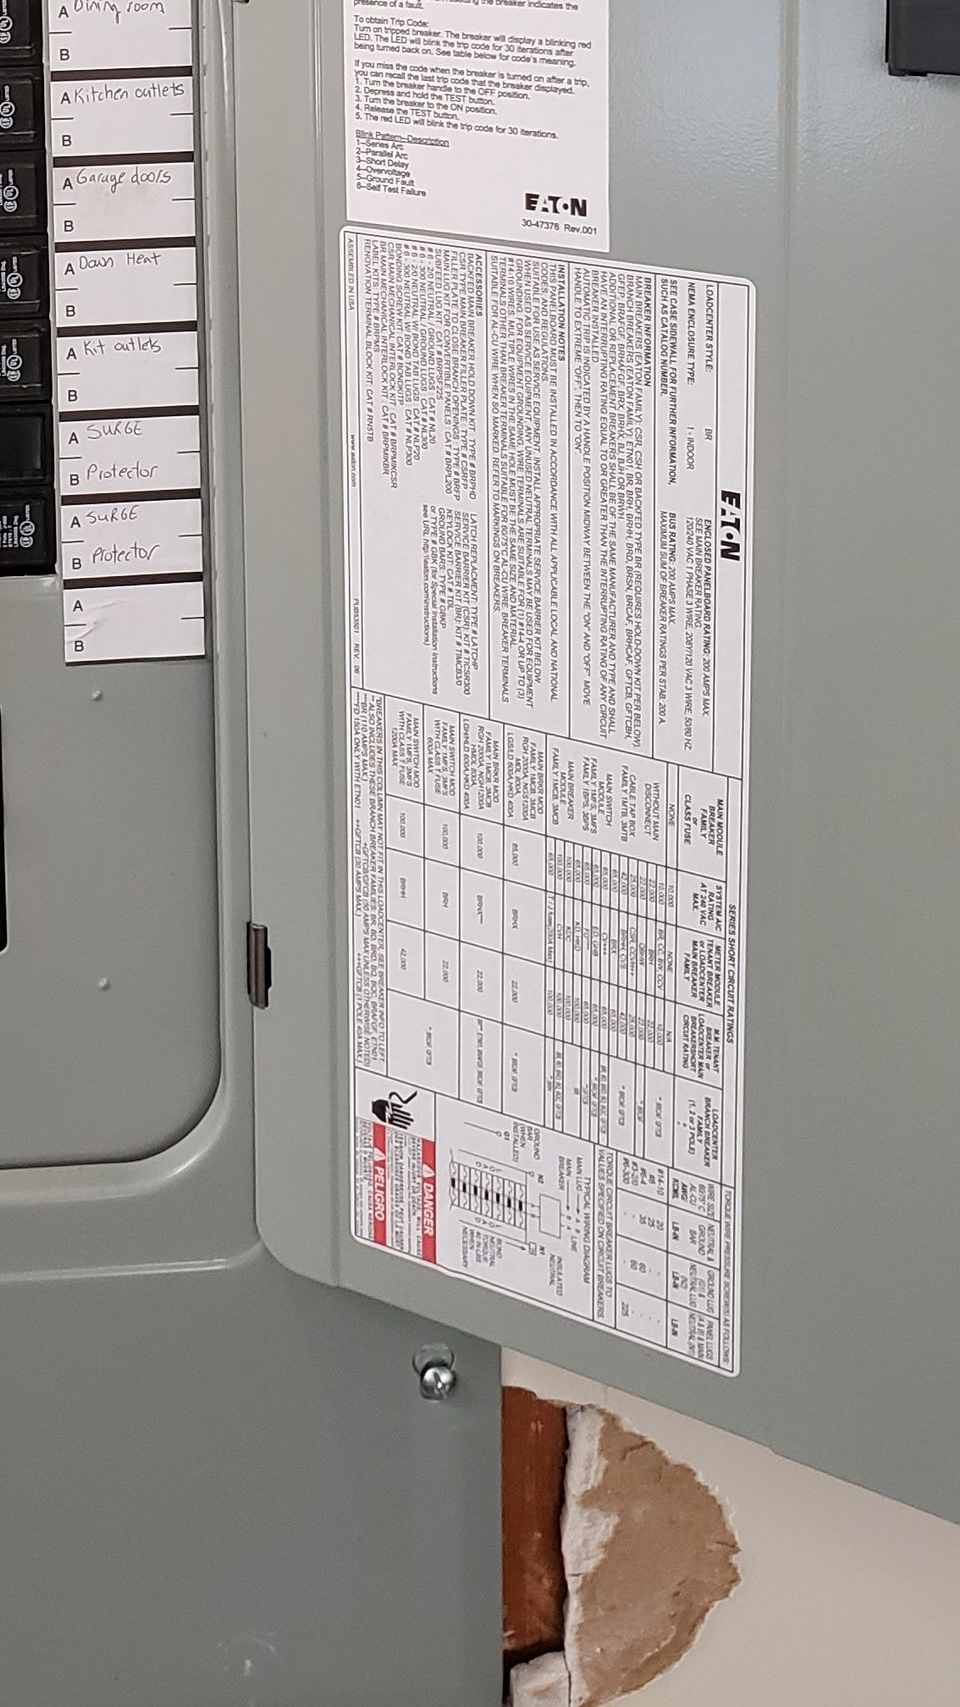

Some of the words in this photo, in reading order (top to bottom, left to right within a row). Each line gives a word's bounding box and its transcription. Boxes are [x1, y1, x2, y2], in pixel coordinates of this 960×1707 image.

[127, 2, 165, 14] room
[353, 14, 365, 23] To
[366, 16, 388, 24] obtain
[390, 18, 404, 26] Trip
[407, 19, 429, 27] Code:
[525, 193, 586, 217] EATON
[706, 285, 714, 341] LOADCENTER
[721, 490, 741, 561] EATON
[72, 599, 84, 613] A
[74, 639, 85, 653] B
[728, 904, 736, 935] SERIES
[374, 1166, 385, 1221] PELIGRO
[423, 1183, 434, 1237] DANGER
